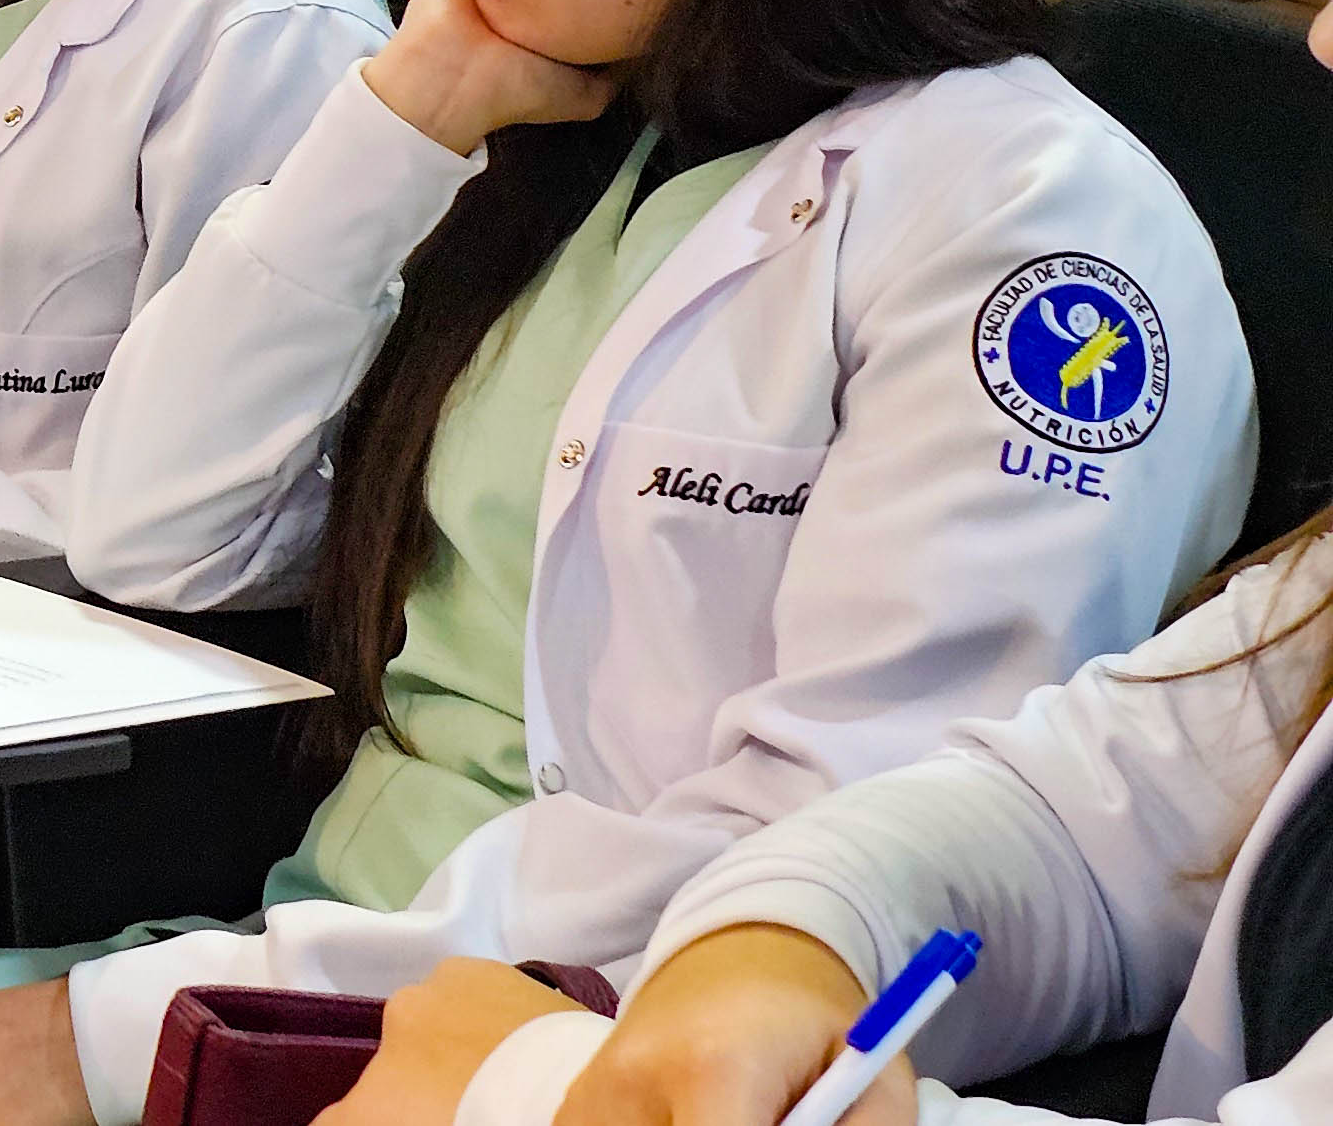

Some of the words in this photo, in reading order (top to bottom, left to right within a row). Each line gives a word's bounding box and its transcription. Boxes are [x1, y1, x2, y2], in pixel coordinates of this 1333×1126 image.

[1033, 262, 1059, 284] DE
[1061, 259, 1130, 297] CIENCIAS
[982, 276, 1034, 342] FACULTAD
[1129, 293, 1150, 317] DE
[1143, 317, 1160, 339] LA
[1150, 344, 1167, 397] SALUD
[993, 380, 1142, 447] NUTRICIÓN
[1000, 439, 1110, 502] U.P.E.
[723, 482, 812, 517] Card
